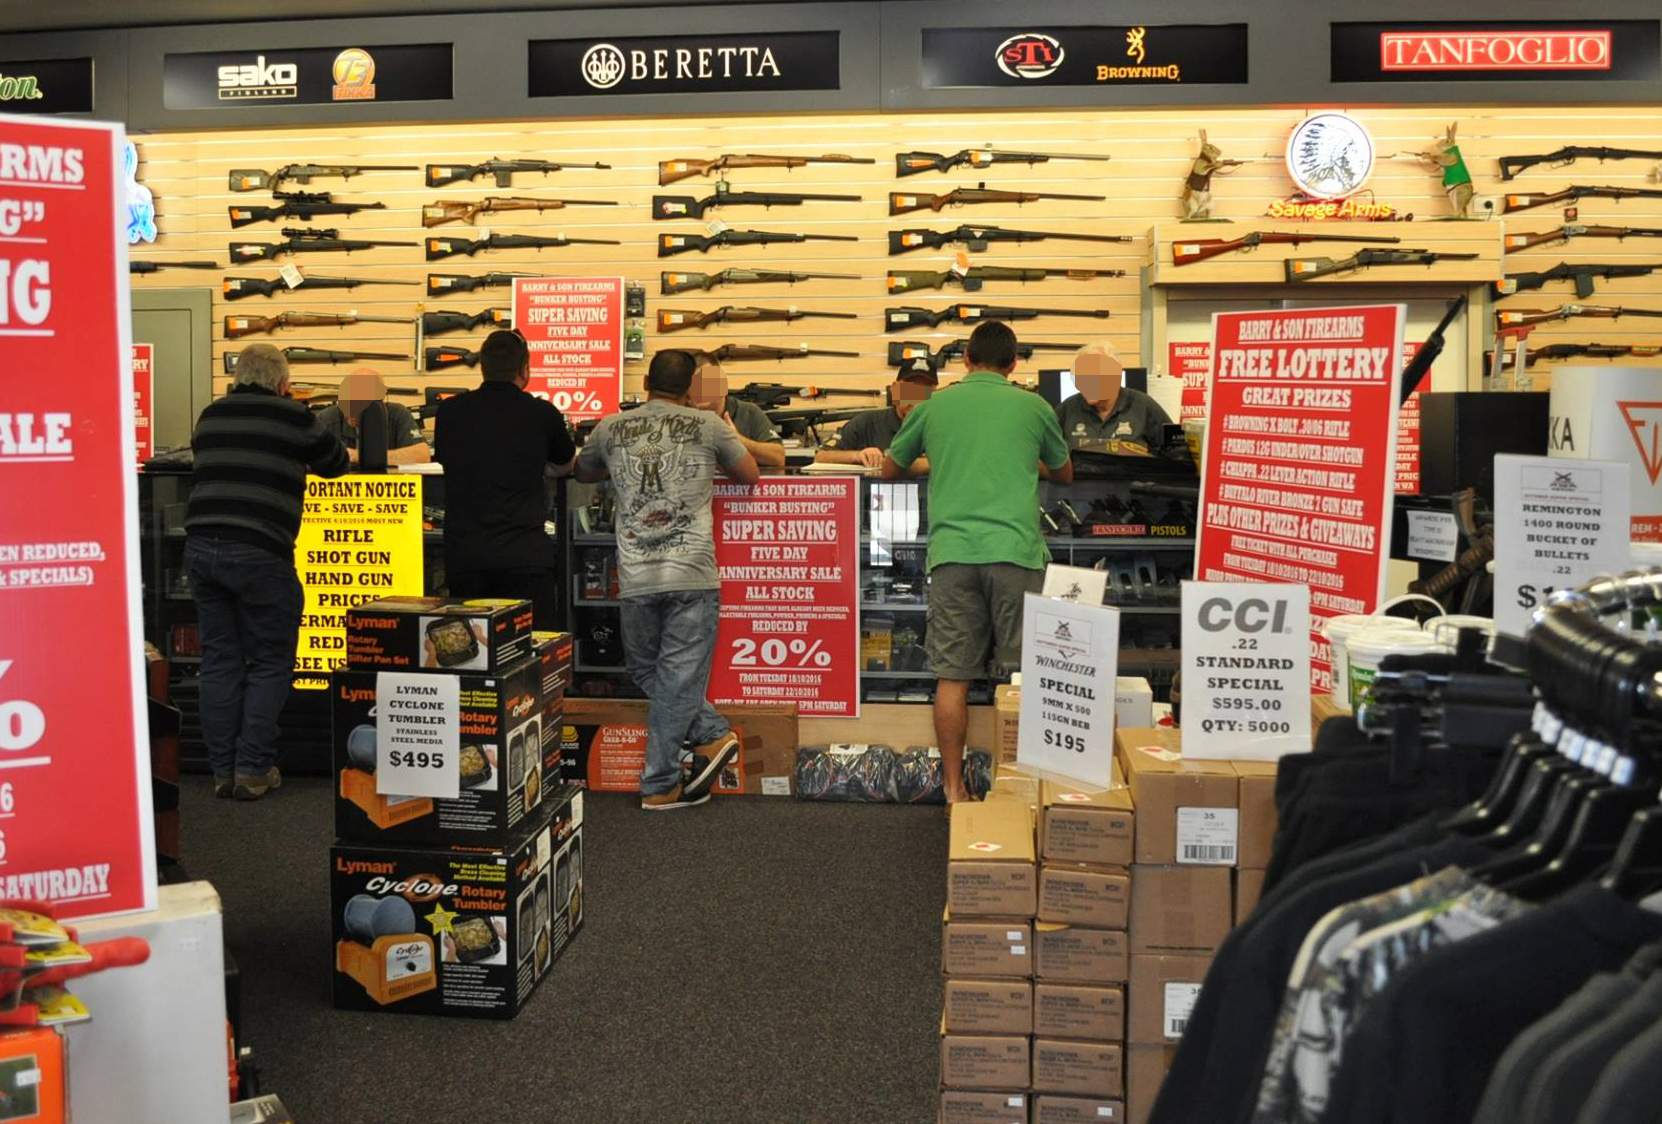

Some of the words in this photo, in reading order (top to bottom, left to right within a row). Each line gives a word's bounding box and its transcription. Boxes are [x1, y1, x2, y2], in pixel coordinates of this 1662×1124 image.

[1386, 36, 1606, 64] TANFOGLIO
[218, 55, 297, 87] sako
[631, 48, 781, 80] BERETTA
[1096, 65, 1180, 81] BROWNING
[0, 143, 85, 183] RMS
[1270, 199, 1337, 220] Savage
[1338, 199, 1393, 218] Arms
[528, 307, 565, 322] SUPER
[567, 307, 608, 322] SAVING
[548, 326, 568, 336] FIVE
[570, 326, 588, 336] DAY
[1239, 319, 1273, 340] BARRY
[1282, 318, 1304, 339] SON
[1305, 316, 1365, 338] FIREARMS
[543, 354, 561, 364] ALL
[561, 354, 592, 364] STOCK
[1218, 349, 1273, 377] FREE
[1276, 347, 1389, 379] LOTTERY
[1242, 386, 1291, 406] GREAT
[1292, 388, 1351, 408] PRIZES
[1323, 420, 1350, 437] RIFLE
[1322, 445, 1364, 464] SHOTGUN
[1329, 471, 1355, 489] RIFLE
[365, 482, 416, 497] NOTICE
[762, 485, 785, 495] SON
[787, 484, 847, 495] FIREARMS
[332, 504, 364, 513] SAVE
[376, 504, 408, 513] SAVE
[723, 502, 778, 513] “BUNKER
[779, 502, 835, 513] BUSTING”
[1341, 498, 1364, 516] SAFE
[1522, 504, 1602, 516] REMINGTON
[722, 520, 775, 541] SUPER
[778, 520, 837, 541] SAVING
[1150, 525, 1187, 535] PISTOLS
[1206, 503, 1230, 525] PLUS
[1230, 506, 1262, 531] OTHER
[1262, 511, 1299, 538] PRIZES
[1310, 518, 1375, 550] GIVEAWAYS
[1524, 519, 1553, 529] 1400
[1556, 520, 1600, 531] ROUND
[323, 529, 374, 542] RIFLE
[1526, 534, 1577, 545] BUCKET
[22, 542, 105, 562] REDUCED,
[306, 551, 352, 564] SHOT
[356, 552, 391, 564] GUN
[751, 547, 780, 560] FIVE
[783, 547, 808, 560] DAY
[1534, 550, 1590, 561] BULLETS
[10, 566, 94, 585] SPECIALS)
[718, 566, 808, 579] ANNIVERSARY
[810, 567, 842, 579] SALE
[1553, 566, 1572, 574] .22
[305, 572, 353, 585] HAND
[358, 573, 393, 586] GUN
[745, 586, 769, 599] ALL
[771, 586, 815, 599] STOCK
[1198, 597, 1288, 633] CCI
[348, 615, 397, 630] Lyman
[752, 620, 794, 631] REDUCED
[796, 621, 808, 631] BY
[1232, 638, 1258, 650] .22
[731, 638, 831, 666] 20%
[1035, 654, 1096, 677] WINCHESTER
[1196, 656, 1294, 670] STANDARD
[396, 686, 438, 695] LYMAN
[1040, 677, 1095, 700] SPECIAL
[1207, 677, 1284, 691] SPECIAL
[389, 700, 444, 711] CYCLONE
[1065, 703, 1073, 711] X
[1212, 697, 1282, 710] $595.00
[388, 715, 446, 725] TUMBLER
[1202, 719, 1243, 733] QTY:
[1248, 721, 1290, 733] 5000
[1044, 728, 1086, 753] $195
[389, 750, 444, 769] $495
[337, 857, 394, 874] Lyman
[366, 877, 459, 895] Cyclone
[461, 885, 506, 899] Rotary
[454, 898, 507, 911] Tumbler
